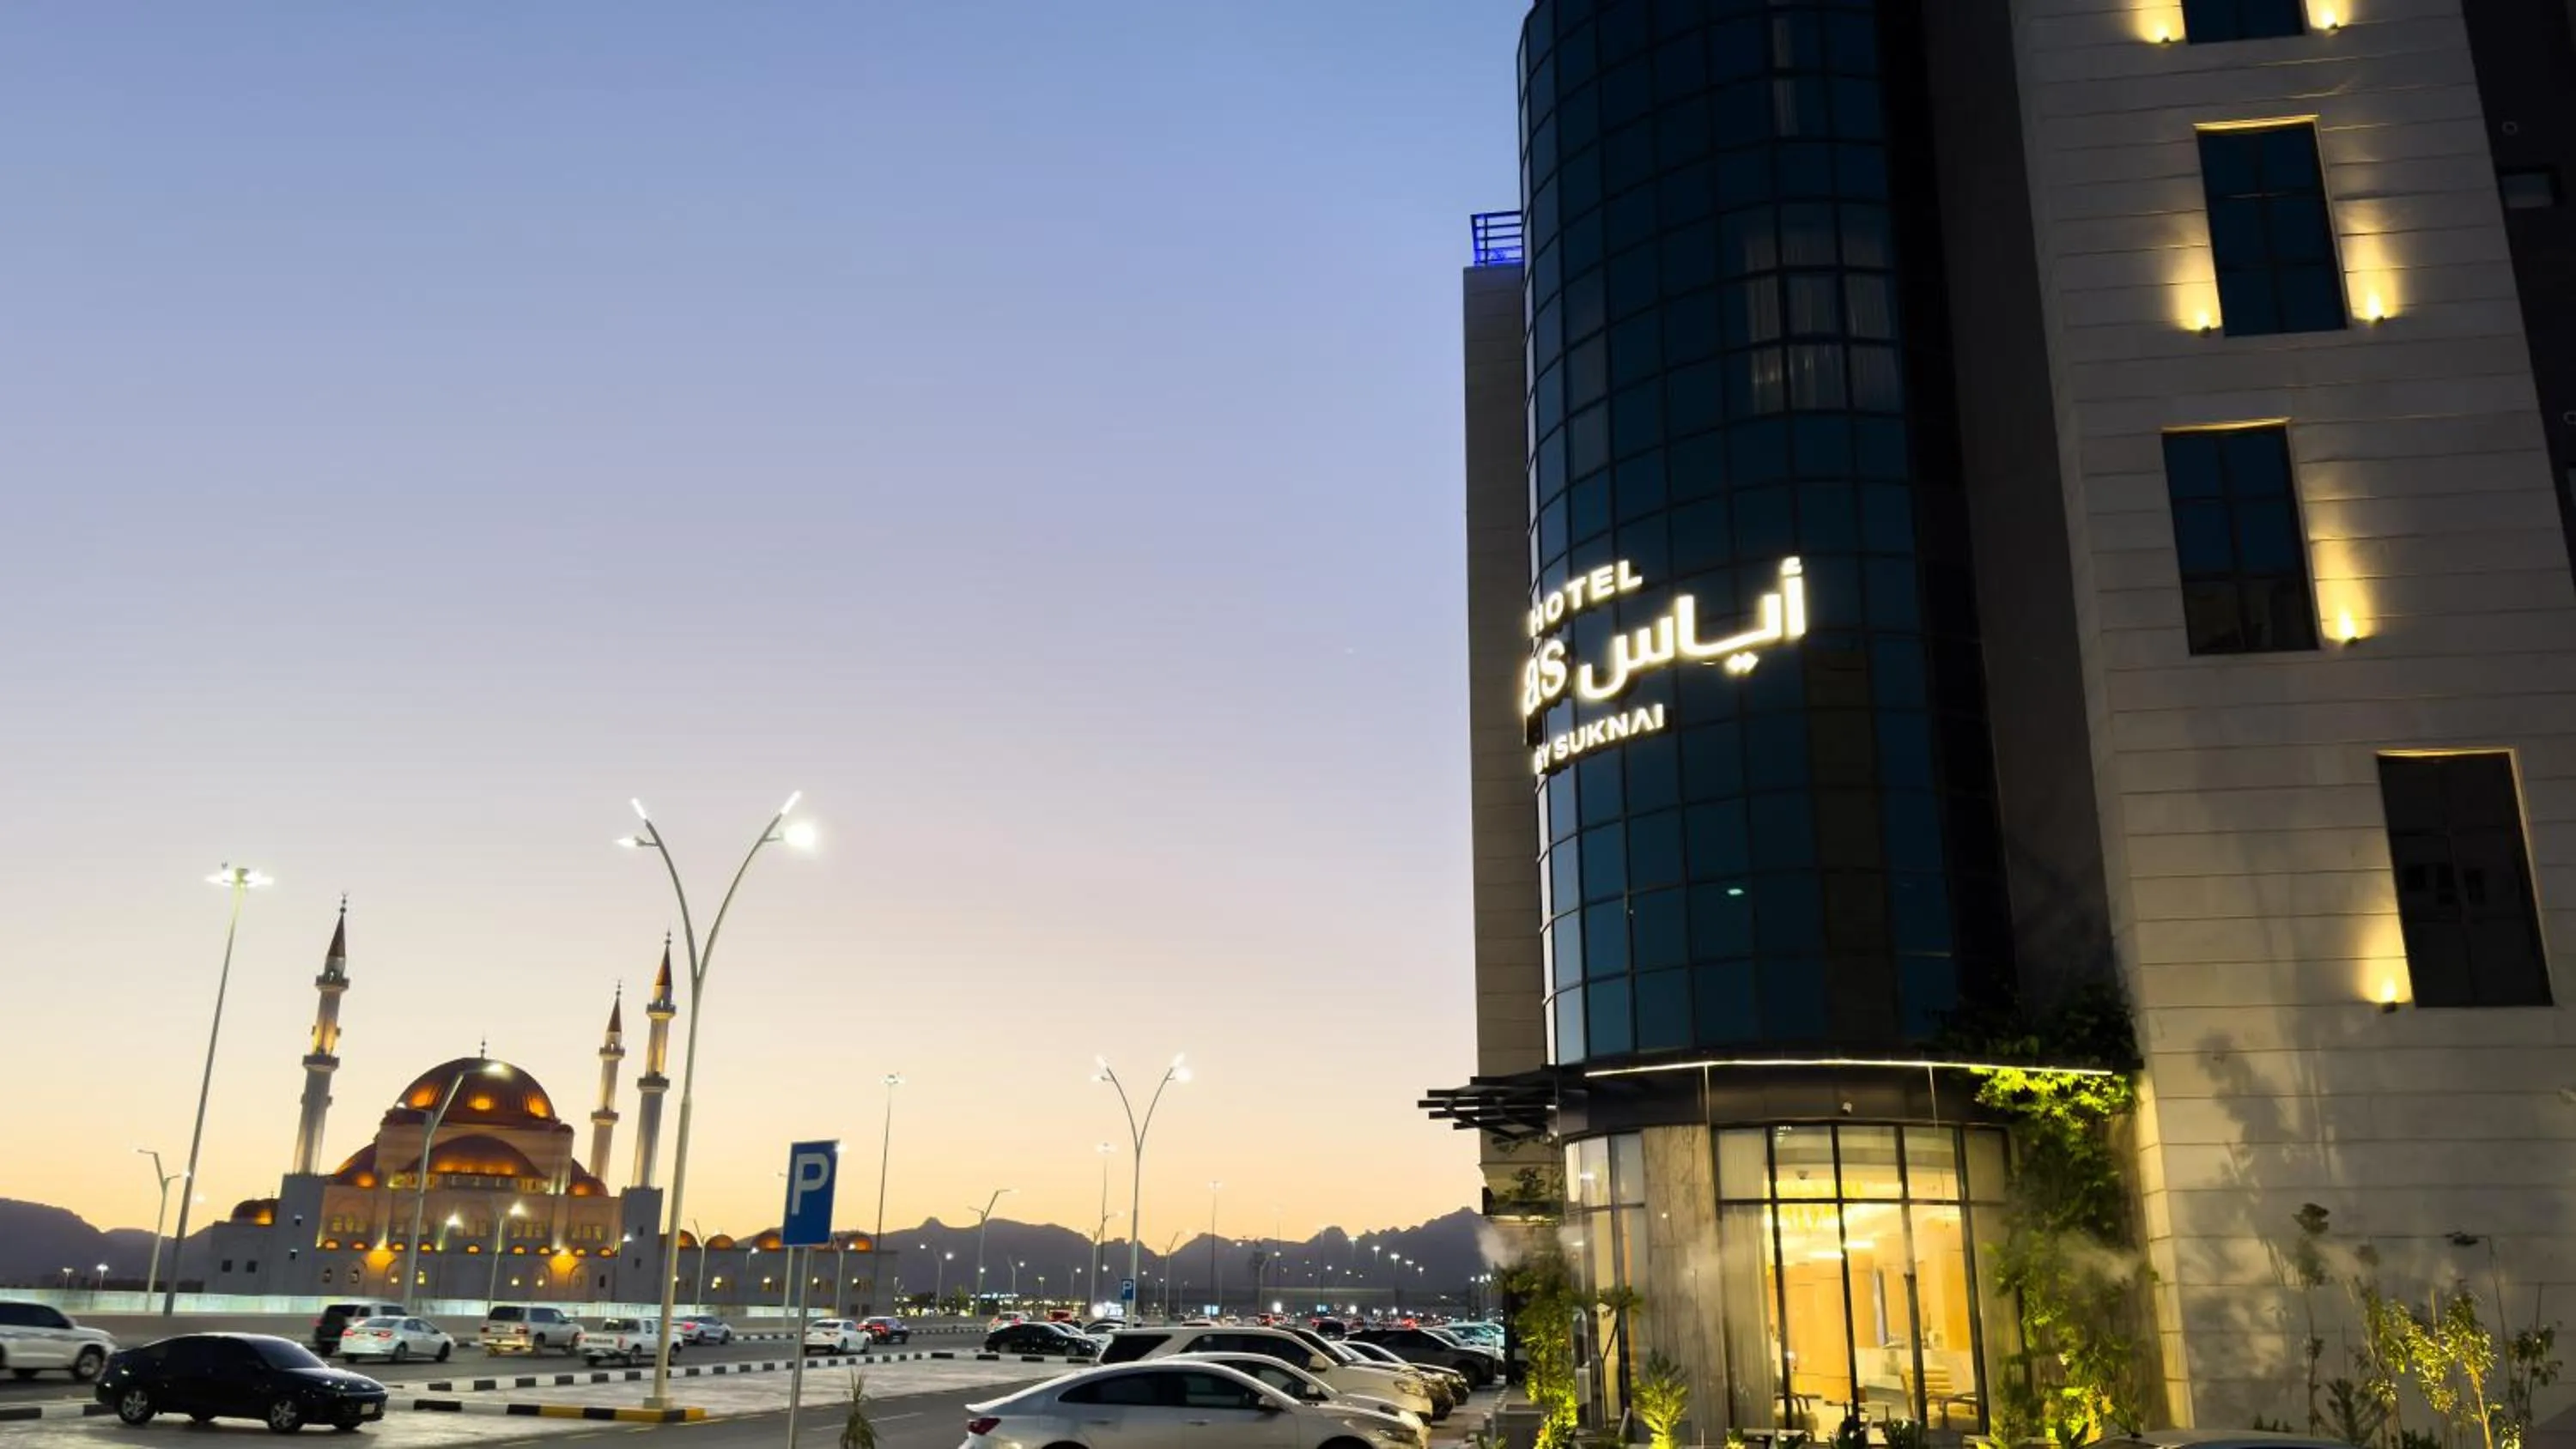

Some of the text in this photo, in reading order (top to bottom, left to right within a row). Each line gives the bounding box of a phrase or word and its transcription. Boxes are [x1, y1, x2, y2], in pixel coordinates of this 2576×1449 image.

[1528, 560, 1643, 637] HOTEL
[1578, 556, 1805, 700] أياس
[1553, 704, 1665, 760] SUKNAI
[792, 1153, 829, 1216] P
[1122, 1281, 1133, 1295] P
